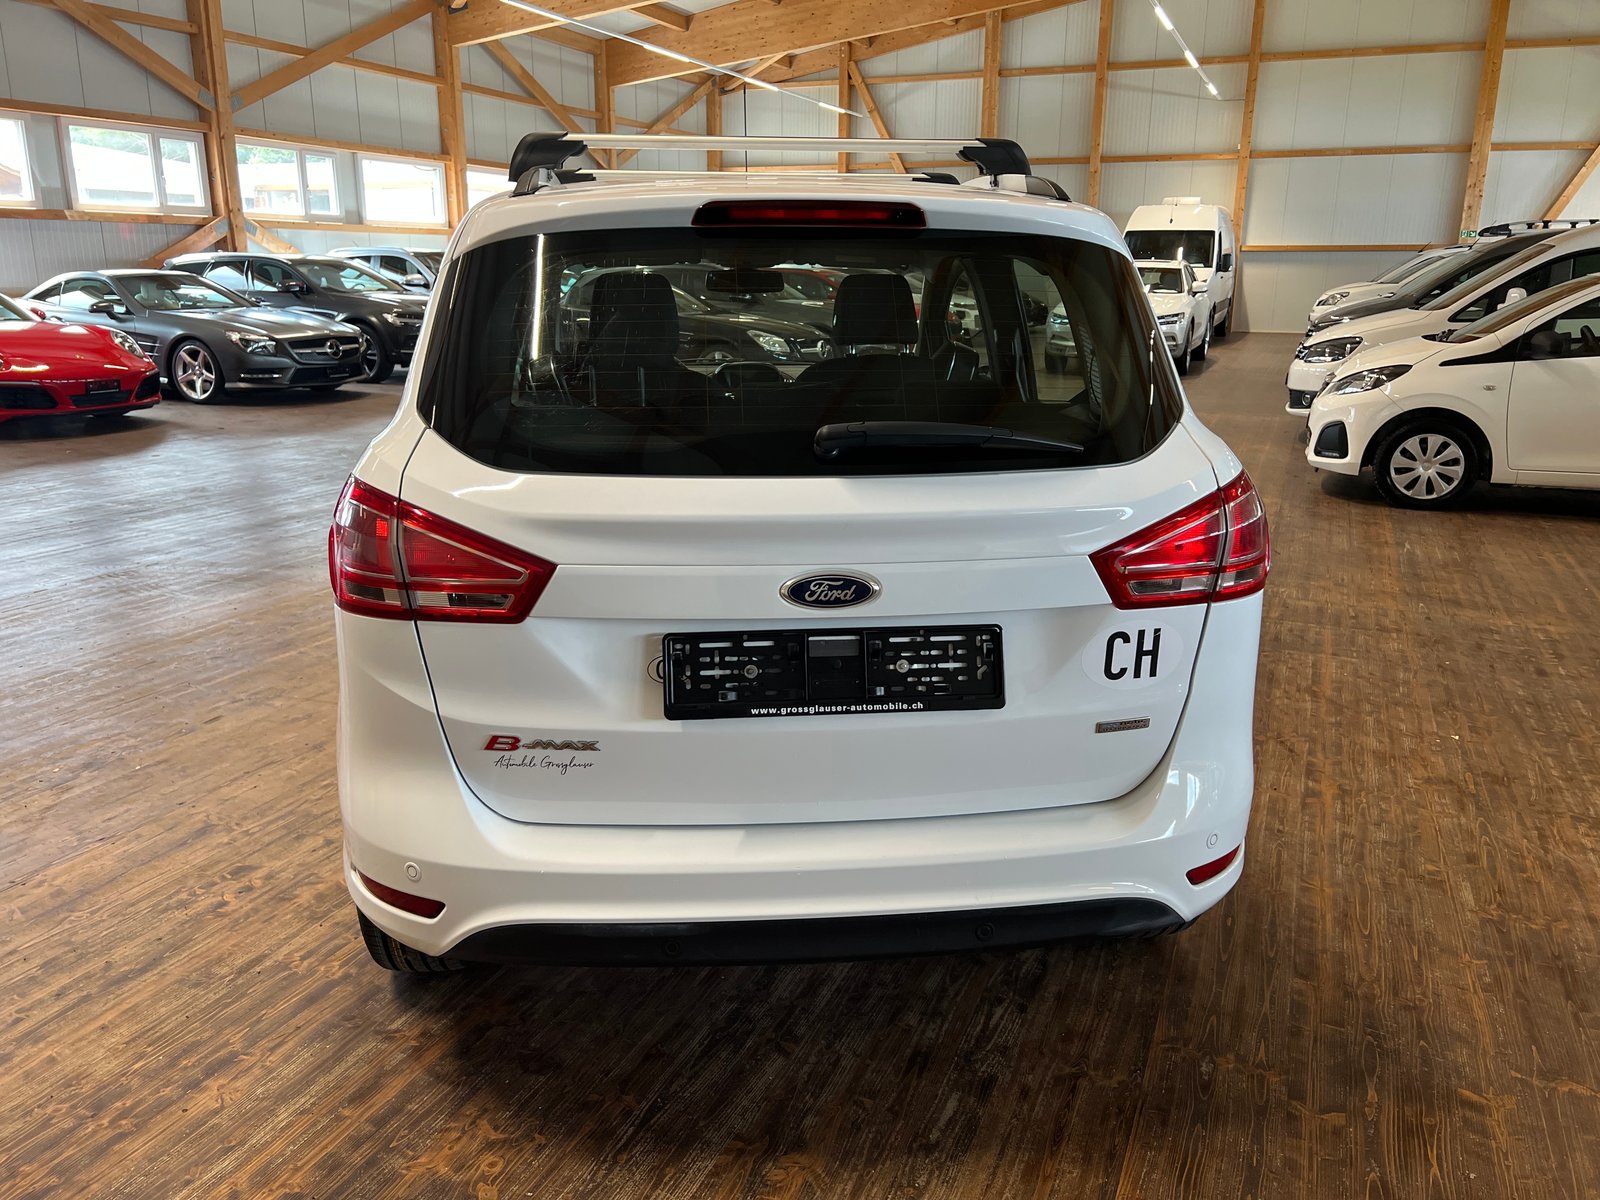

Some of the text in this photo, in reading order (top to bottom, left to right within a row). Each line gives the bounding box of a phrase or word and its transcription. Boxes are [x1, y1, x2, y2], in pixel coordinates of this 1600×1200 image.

[804, 580, 856, 602] Ford
[1104, 628, 1161, 680] CH
[750, 701, 924, 715] www.grossglauser-automobile.ch
[540, 754, 594, 775] Grossglauser
